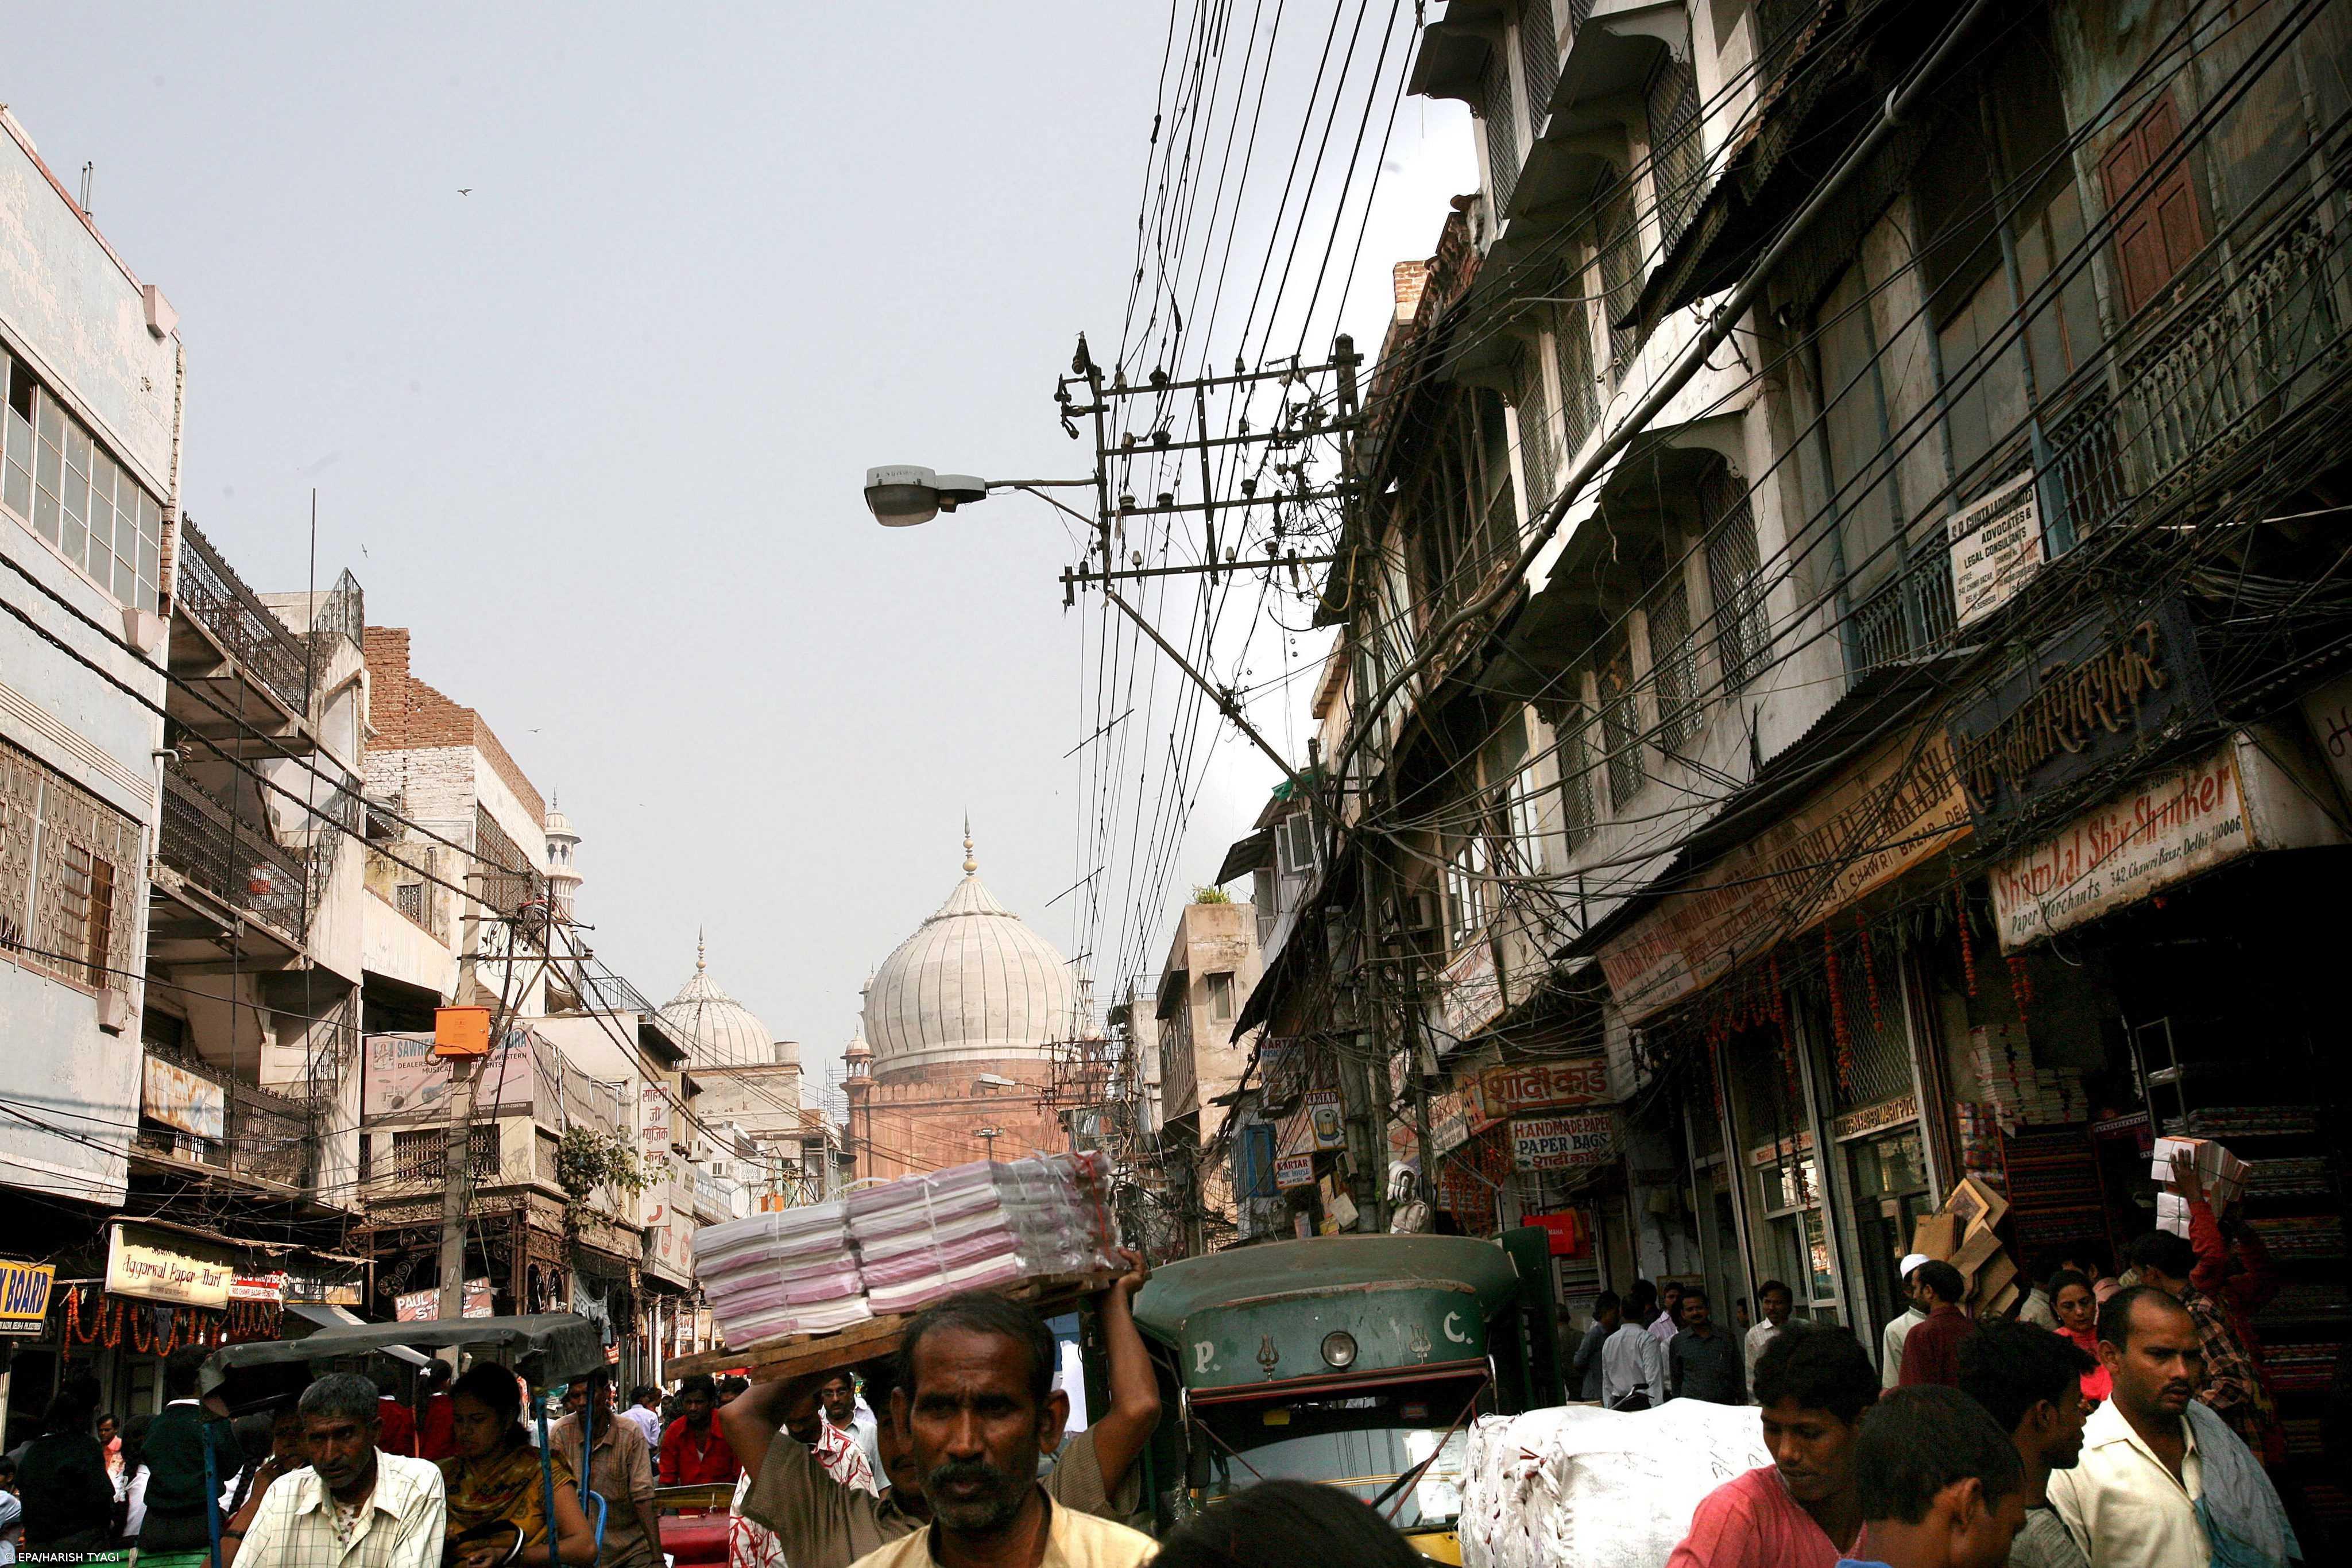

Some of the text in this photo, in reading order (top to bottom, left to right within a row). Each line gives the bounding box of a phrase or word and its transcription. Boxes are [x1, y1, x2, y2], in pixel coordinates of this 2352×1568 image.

[1982, 506, 2032, 544] ADVOCATES &
[1964, 551, 1984, 569] LEGAL
[1985, 526, 2026, 557] CONSULTANTS
[2133, 765, 2230, 847] Shanker
[1848, 852, 1894, 888] CHAWRI
[1899, 822, 1936, 857] BAZAR
[2011, 905, 2038, 935] Paper
[495, 1052, 527, 1061] WESTERN
[422, 1065, 452, 1074] MUSICAL
[1488, 1060, 1607, 1102] शादी कार्ड
[1307, 1093, 1337, 1104] KARTAR
[649, 1106, 661, 1121] जी
[1514, 1116, 1612, 1138] HANDMADE PAPER
[1518, 1133, 1607, 1155] PAPER BAGS
[1277, 1159, 1308, 1170] KARTAR
[1533, 1152, 1569, 1168] शादी
[123, 1254, 167, 1279] Aggarwal
[169, 1263, 195, 1287] Paper
[5, 1269, 48, 1314] BOARD
[397, 1293, 428, 1311] PAUL
